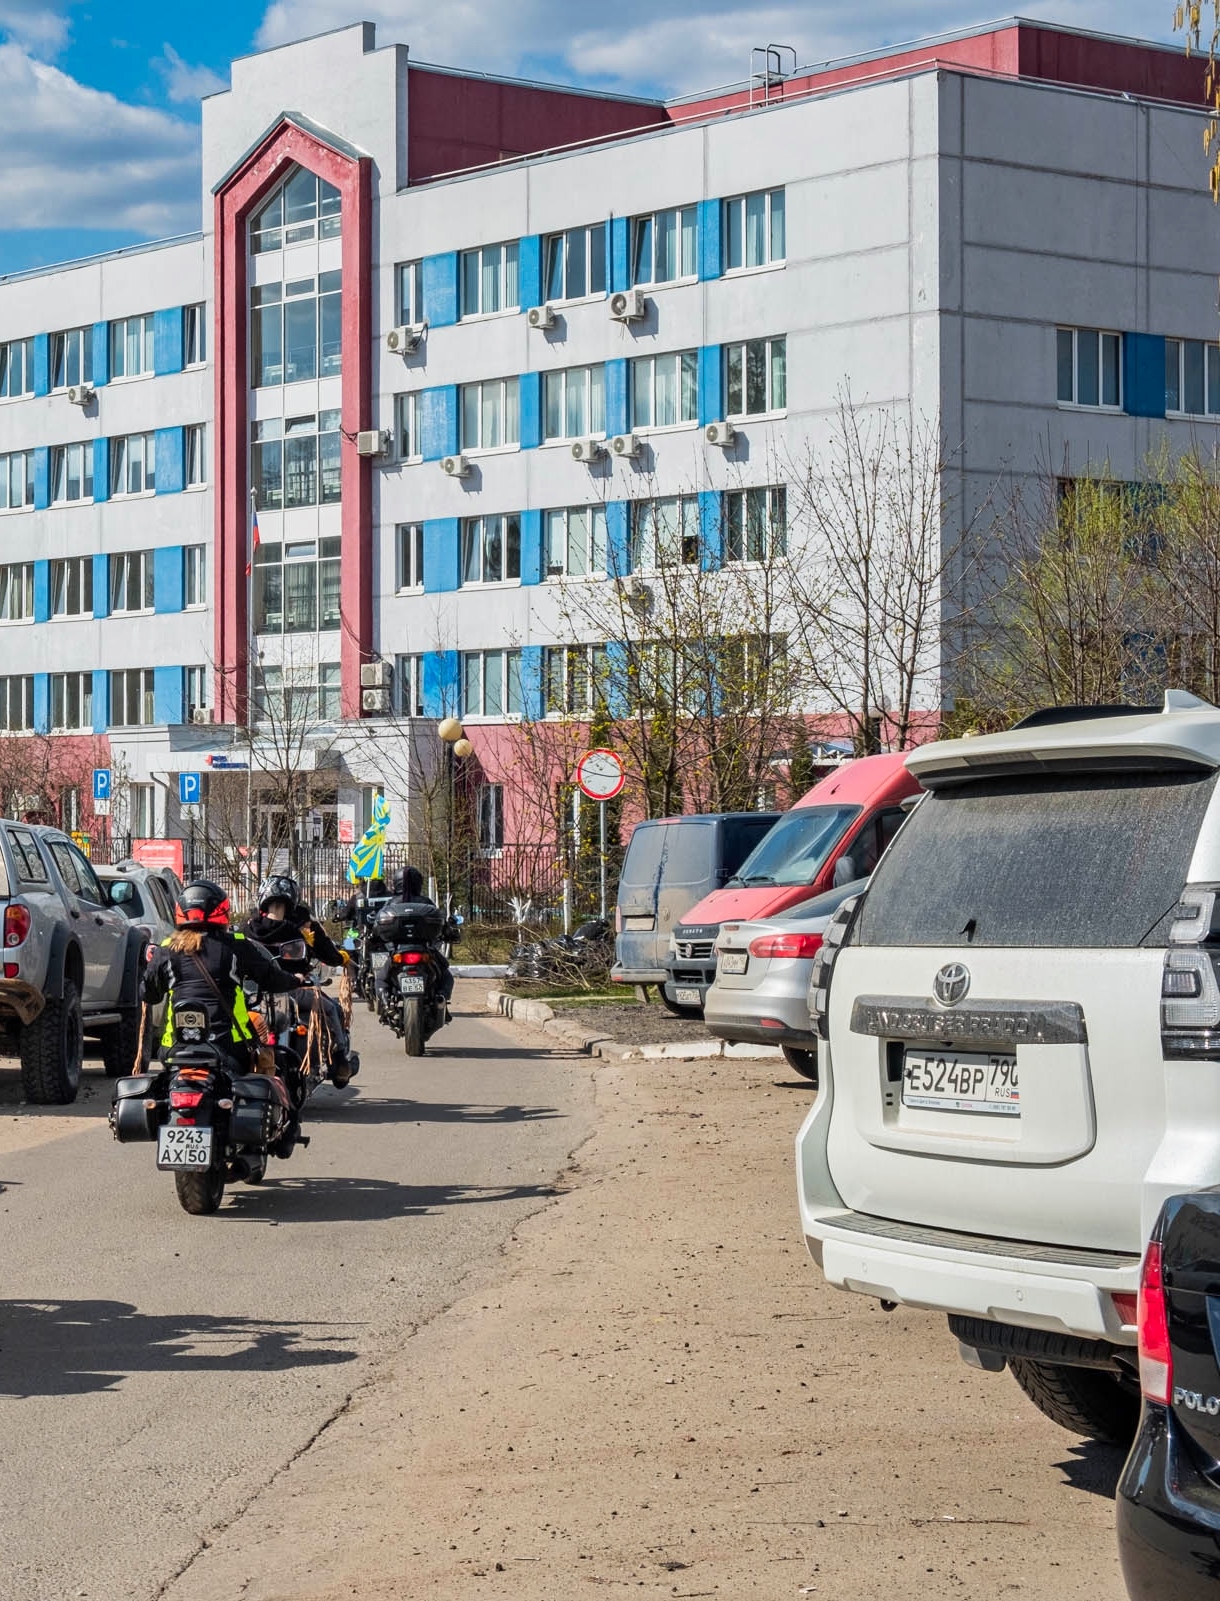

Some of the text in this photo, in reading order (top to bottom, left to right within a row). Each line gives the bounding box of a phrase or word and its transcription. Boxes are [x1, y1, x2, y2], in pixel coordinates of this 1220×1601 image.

[994, 1087, 1011, 1098] RUS
[167, 1130, 204, 1144] 9243
[188, 1150, 207, 1163] 50
[1174, 1386, 1219, 1415] POLO
